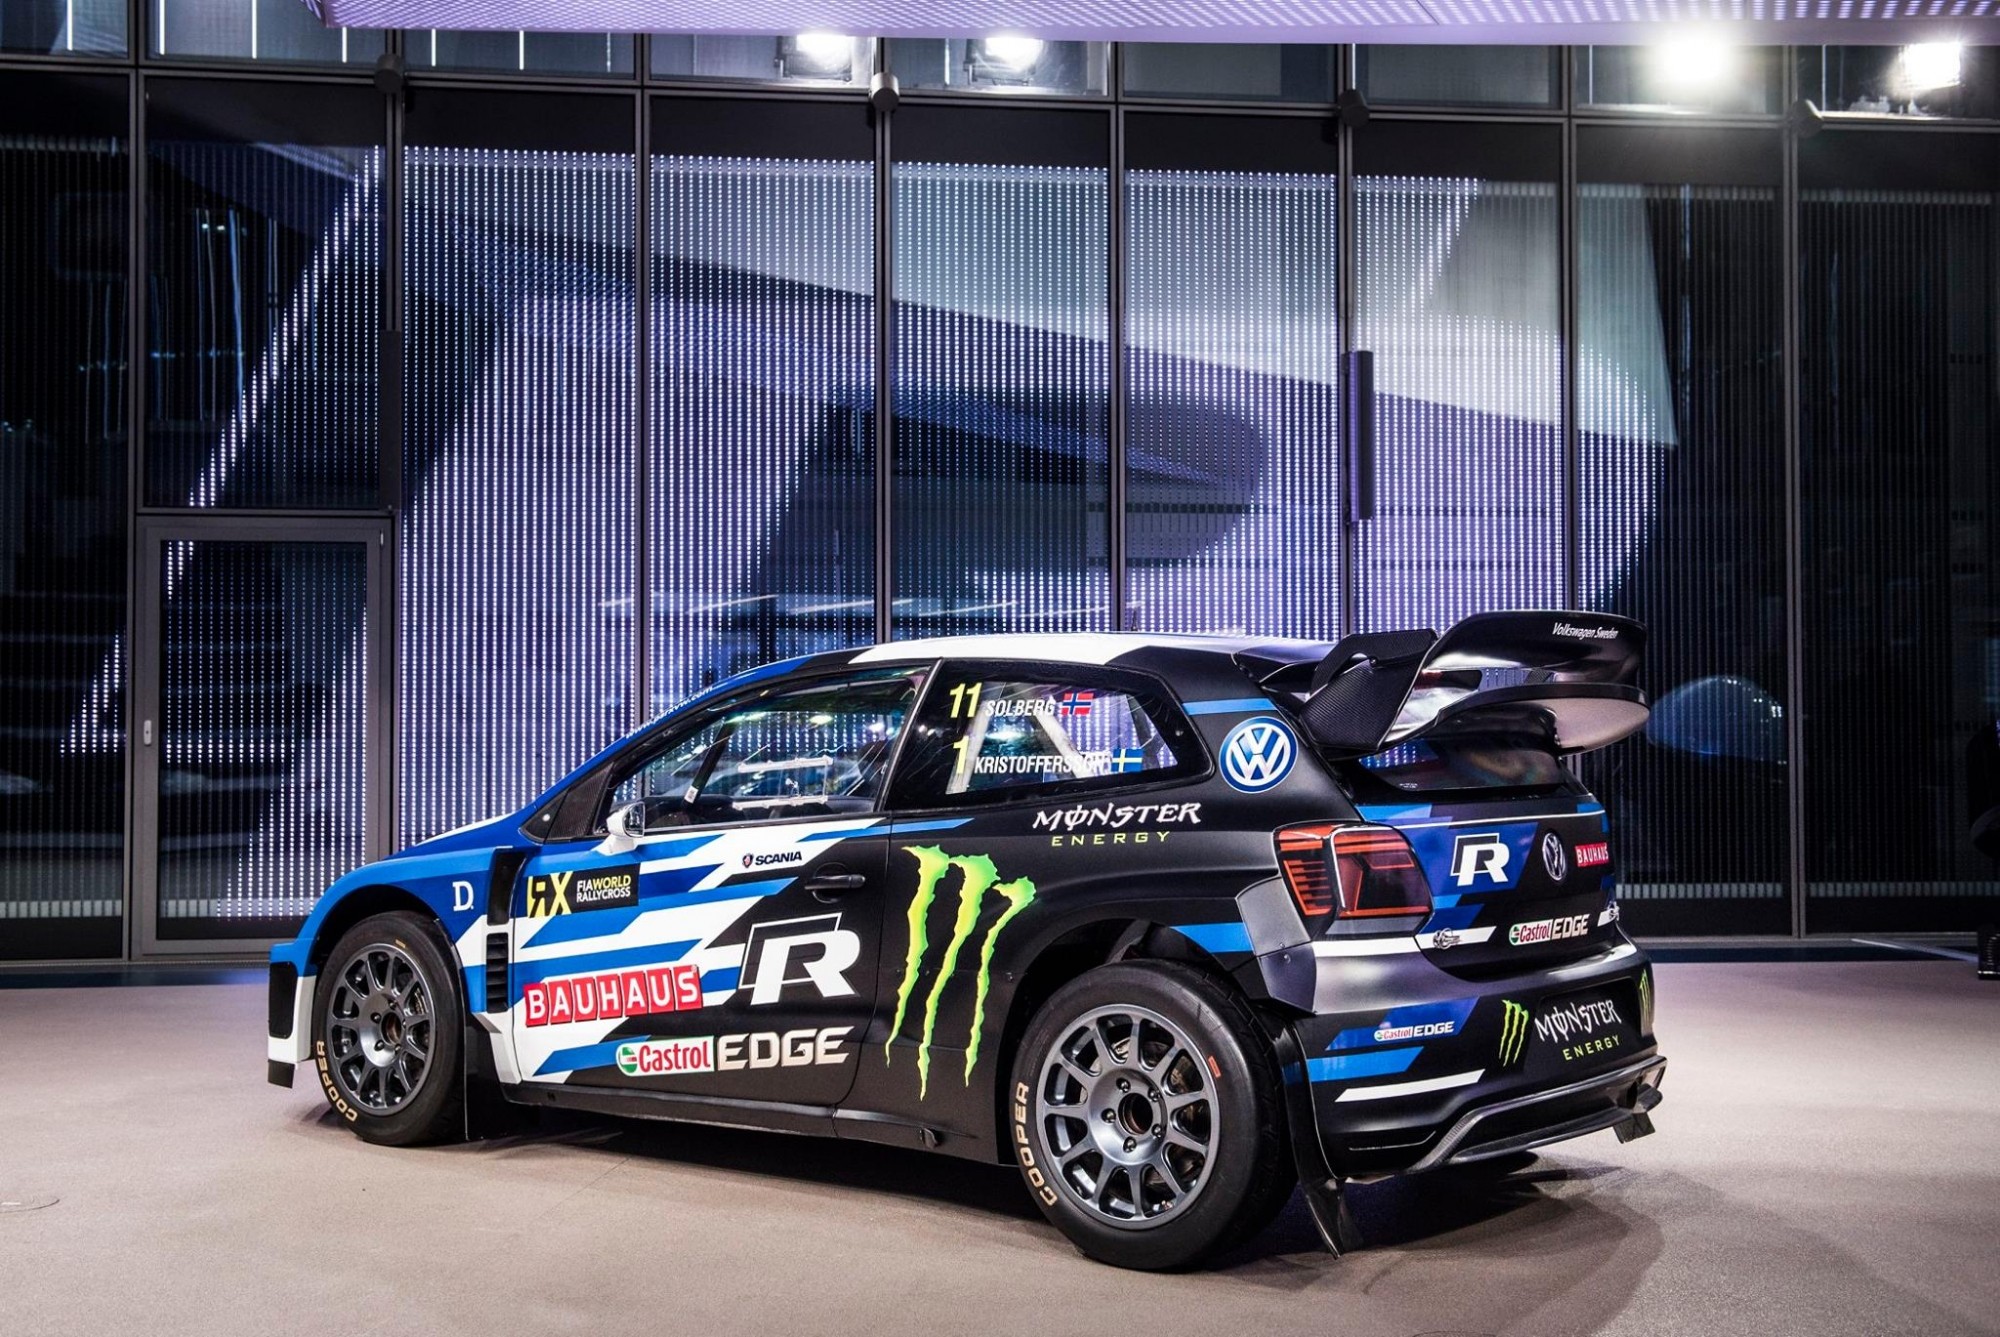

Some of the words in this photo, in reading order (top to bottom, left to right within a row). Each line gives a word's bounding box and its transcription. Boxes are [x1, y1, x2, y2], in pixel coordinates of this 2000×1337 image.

[1552, 622, 1596, 640] Volkswagen
[1594, 627, 1619, 639] Sweden
[950, 682, 982, 718] 11
[985, 698, 1056, 717] SOLBERG
[953, 735, 970, 774] 1
[1051, 831, 1171, 847] ENERGY
[1576, 845, 1609, 864] BAUHAUS
[755, 851, 802, 866] SCANIA
[1454, 839, 1510, 887] R
[576, 886, 631, 903] RALLYCROSS
[1519, 920, 1551, 943] Castrol
[1551, 914, 1590, 940] EDGE
[746, 926, 861, 1006] R
[528, 969, 700, 1019] BAUHAUS
[1382, 1028, 1412, 1040] Castrol
[1413, 1021, 1454, 1037] EDGE
[638, 1040, 711, 1073] Castrol
[717, 1026, 855, 1071] EDGE
[1563, 1035, 1621, 1061] ENERGY
[316, 1041, 358, 1122] COOPER
[1015, 1081, 1058, 1207] COOPER
